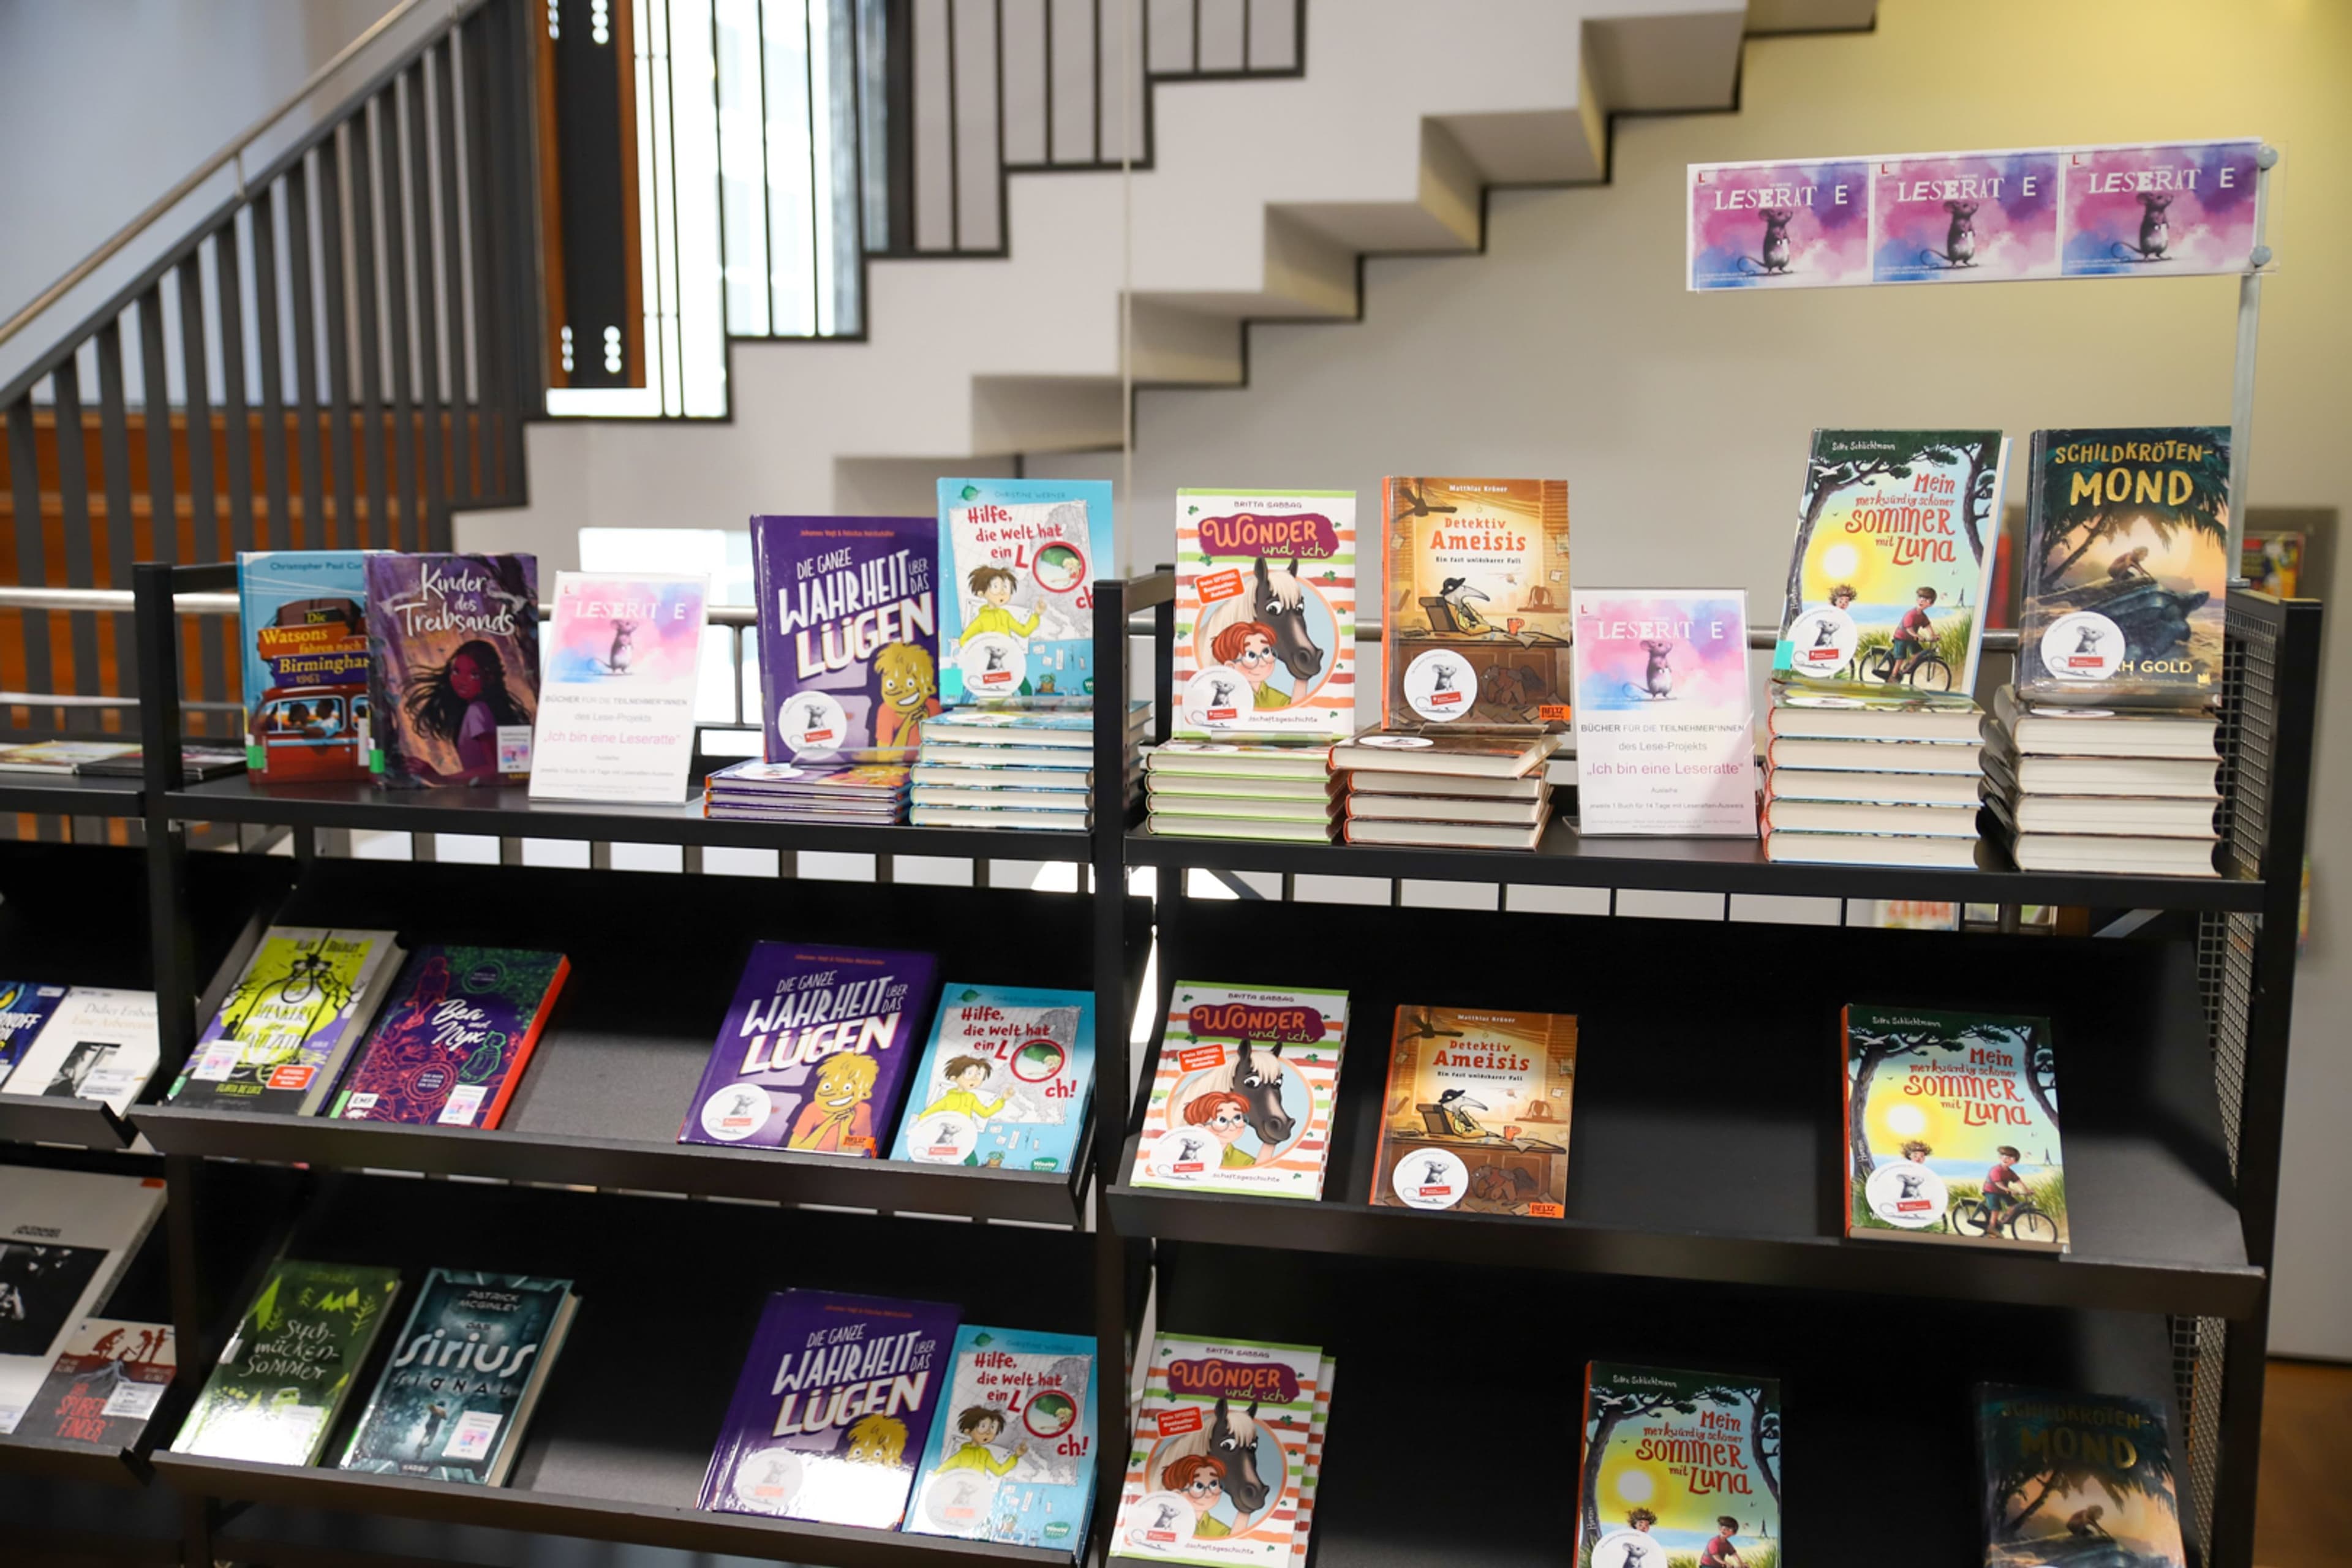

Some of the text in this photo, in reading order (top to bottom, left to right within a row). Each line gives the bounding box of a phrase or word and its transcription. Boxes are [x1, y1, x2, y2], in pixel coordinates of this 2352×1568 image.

[2055, 440, 2213, 464] SCHILDKRÖTEN-
[1449, 484, 1481, 493] Matthias
[1913, 473, 1955, 494] Mein
[2070, 467, 2193, 506] MOND
[1855, 490, 1956, 507] merkwürdig schöner
[968, 505, 1012, 524] Hilfe,
[1445, 518, 1506, 529] Detektiv
[976, 528, 997, 542] die
[1037, 524, 1062, 537] hat
[1202, 515, 1317, 547] WONDER
[1262, 541, 1328, 557] und ich
[1430, 530, 1526, 551] Ameisis
[990, 546, 1012, 559] ein
[1875, 536, 1956, 565] mit Luna
[270, 562, 322, 570] Christopher
[797, 548, 852, 580] DIE GANZE
[422, 563, 487, 600] Kinder
[910, 575, 929, 594] DAS
[778, 549, 910, 635] WAHRHEIT
[454, 598, 477, 613] des
[307, 612, 326, 624] Die
[394, 601, 515, 636] Treibsands
[262, 628, 328, 644] Watsons
[796, 592, 934, 679] LÜGEN
[299, 641, 333, 654] fahren
[2141, 660, 2193, 673] GOLD
[545, 695, 580, 703] BÜCHER
[569, 731, 588, 742] bin
[591, 732, 616, 744] eine
[1581, 724, 1621, 733] BÜCHER
[1623, 724, 1641, 733] FÜR
[1619, 742, 1708, 753] des Lese-Projekts
[1616, 763, 1637, 775] bin
[1642, 763, 1670, 775] eine
[776, 970, 837, 993] DIE GANZE
[740, 976, 894, 1037] WAHRHEIT
[881, 997, 904, 1013] DAS
[961, 1006, 1005, 1021] Hilfe,
[1193, 1005, 1305, 1030] WONDER
[963, 1024, 985, 1036] die
[1026, 1024, 1050, 1036] hat
[1249, 1028, 1313, 1042] und ich
[739, 1012, 901, 1076] LÜGEN
[974, 1041, 995, 1050] ein
[1450, 1041, 1511, 1052] Detektiv
[1433, 1050, 1530, 1071] Ameisis
[1970, 1048, 2013, 1067] Mein
[1941, 1100, 2032, 1126] mit Luna
[466, 1291, 521, 1302] PATRICK
[807, 1324, 867, 1348] DIE GANZE
[771, 1331, 921, 1395] WAHRHEIT
[910, 1354, 932, 1372] DAS
[974, 1351, 1017, 1368] Hilfe,
[977, 1373, 997, 1385] die
[1038, 1374, 1061, 1386] hat
[1171, 1360, 1280, 1387] WONDER
[987, 1390, 1008, 1401] ein
[1226, 1385, 1288, 1402] und ich
[773, 1371, 930, 1437] LÜGEN
[1700, 1411, 1741, 1432] Mein
[2022, 1427, 2137, 1469] MOND
[1669, 1466, 1753, 1494] mit Luna
